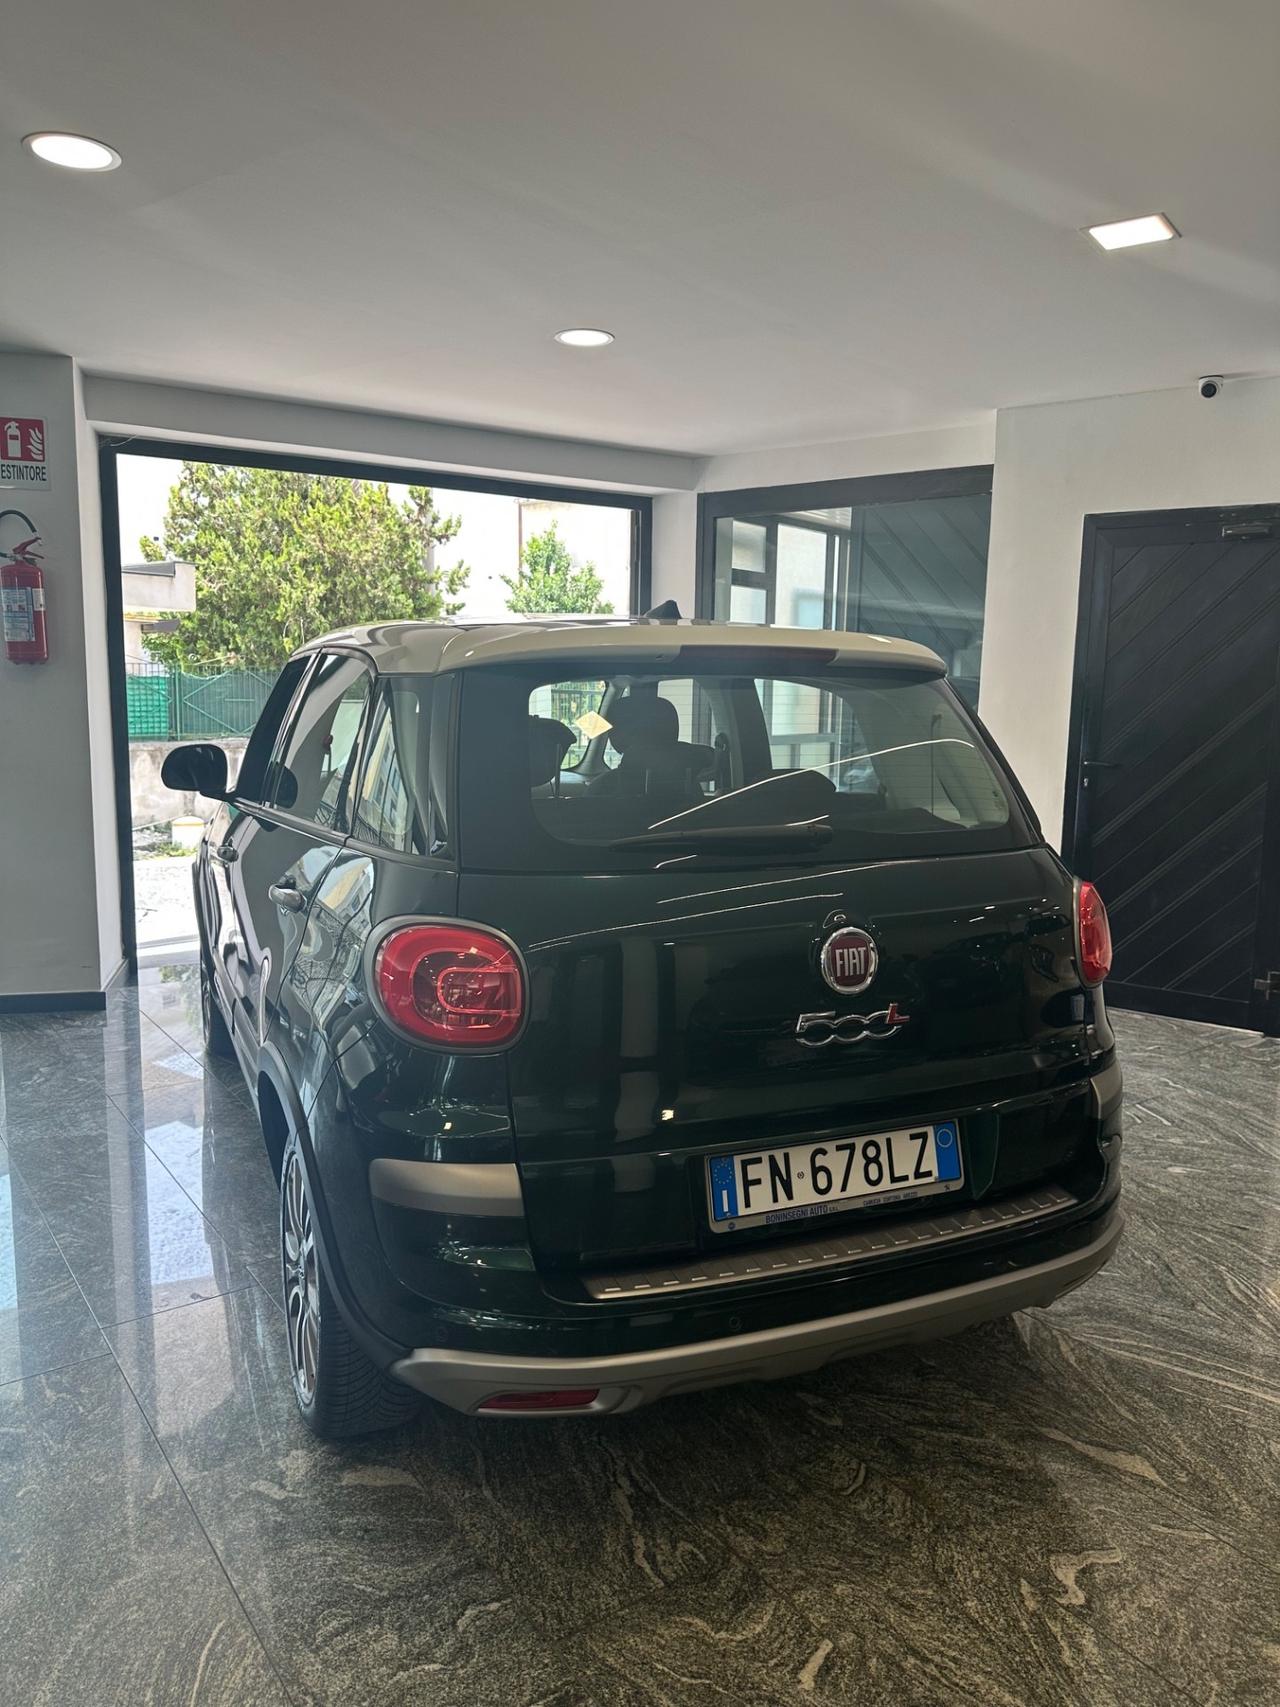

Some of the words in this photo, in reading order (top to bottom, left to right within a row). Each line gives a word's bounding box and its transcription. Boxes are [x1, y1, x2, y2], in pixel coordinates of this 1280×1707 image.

[1, 464, 47, 481] ESTINTORE
[835, 947, 867, 977] FIAT
[795, 1003, 910, 1046] 500L
[741, 1152, 794, 1208] FN
[810, 1131, 933, 1196] 678LZ
[766, 1208, 809, 1224] BONINSEGNI
[810, 1205, 829, 1217] AUTO
